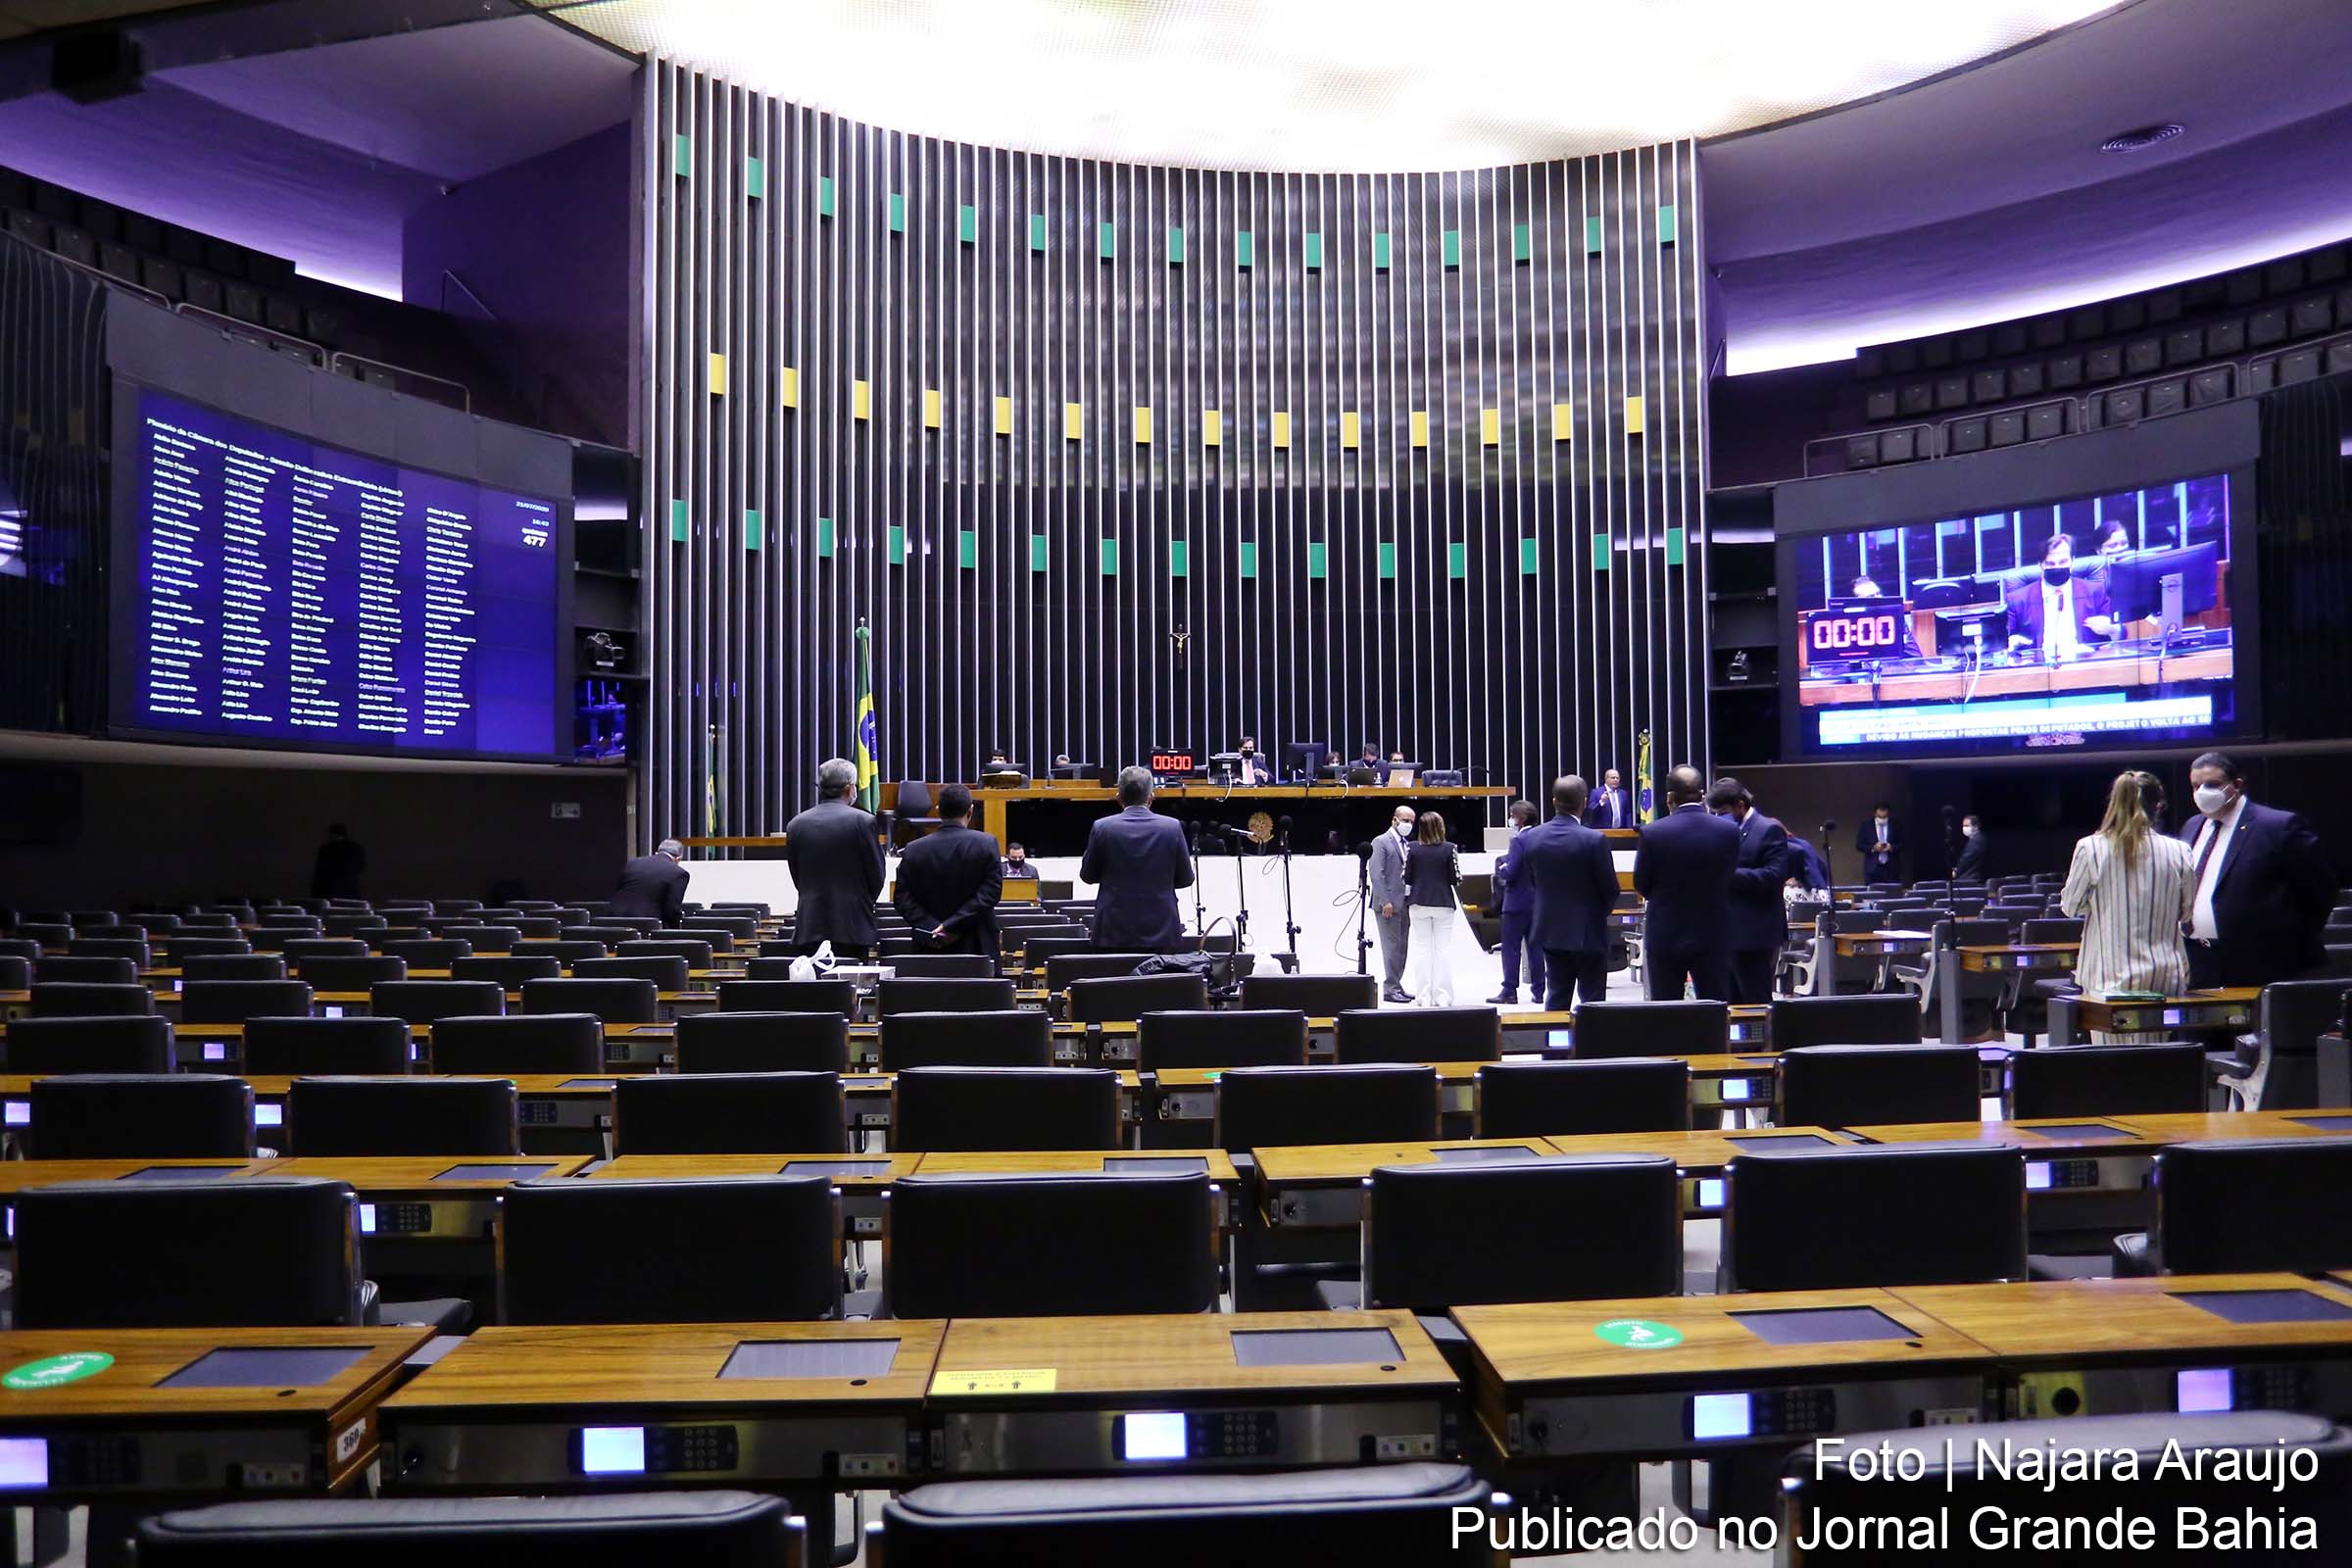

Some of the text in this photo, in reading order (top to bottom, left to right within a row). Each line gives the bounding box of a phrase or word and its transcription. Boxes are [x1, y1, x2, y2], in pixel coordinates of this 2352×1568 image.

[522, 535, 547, 548] 477
[1813, 615, 1896, 650] 00:00
[1152, 755, 1192, 770] 00:00
